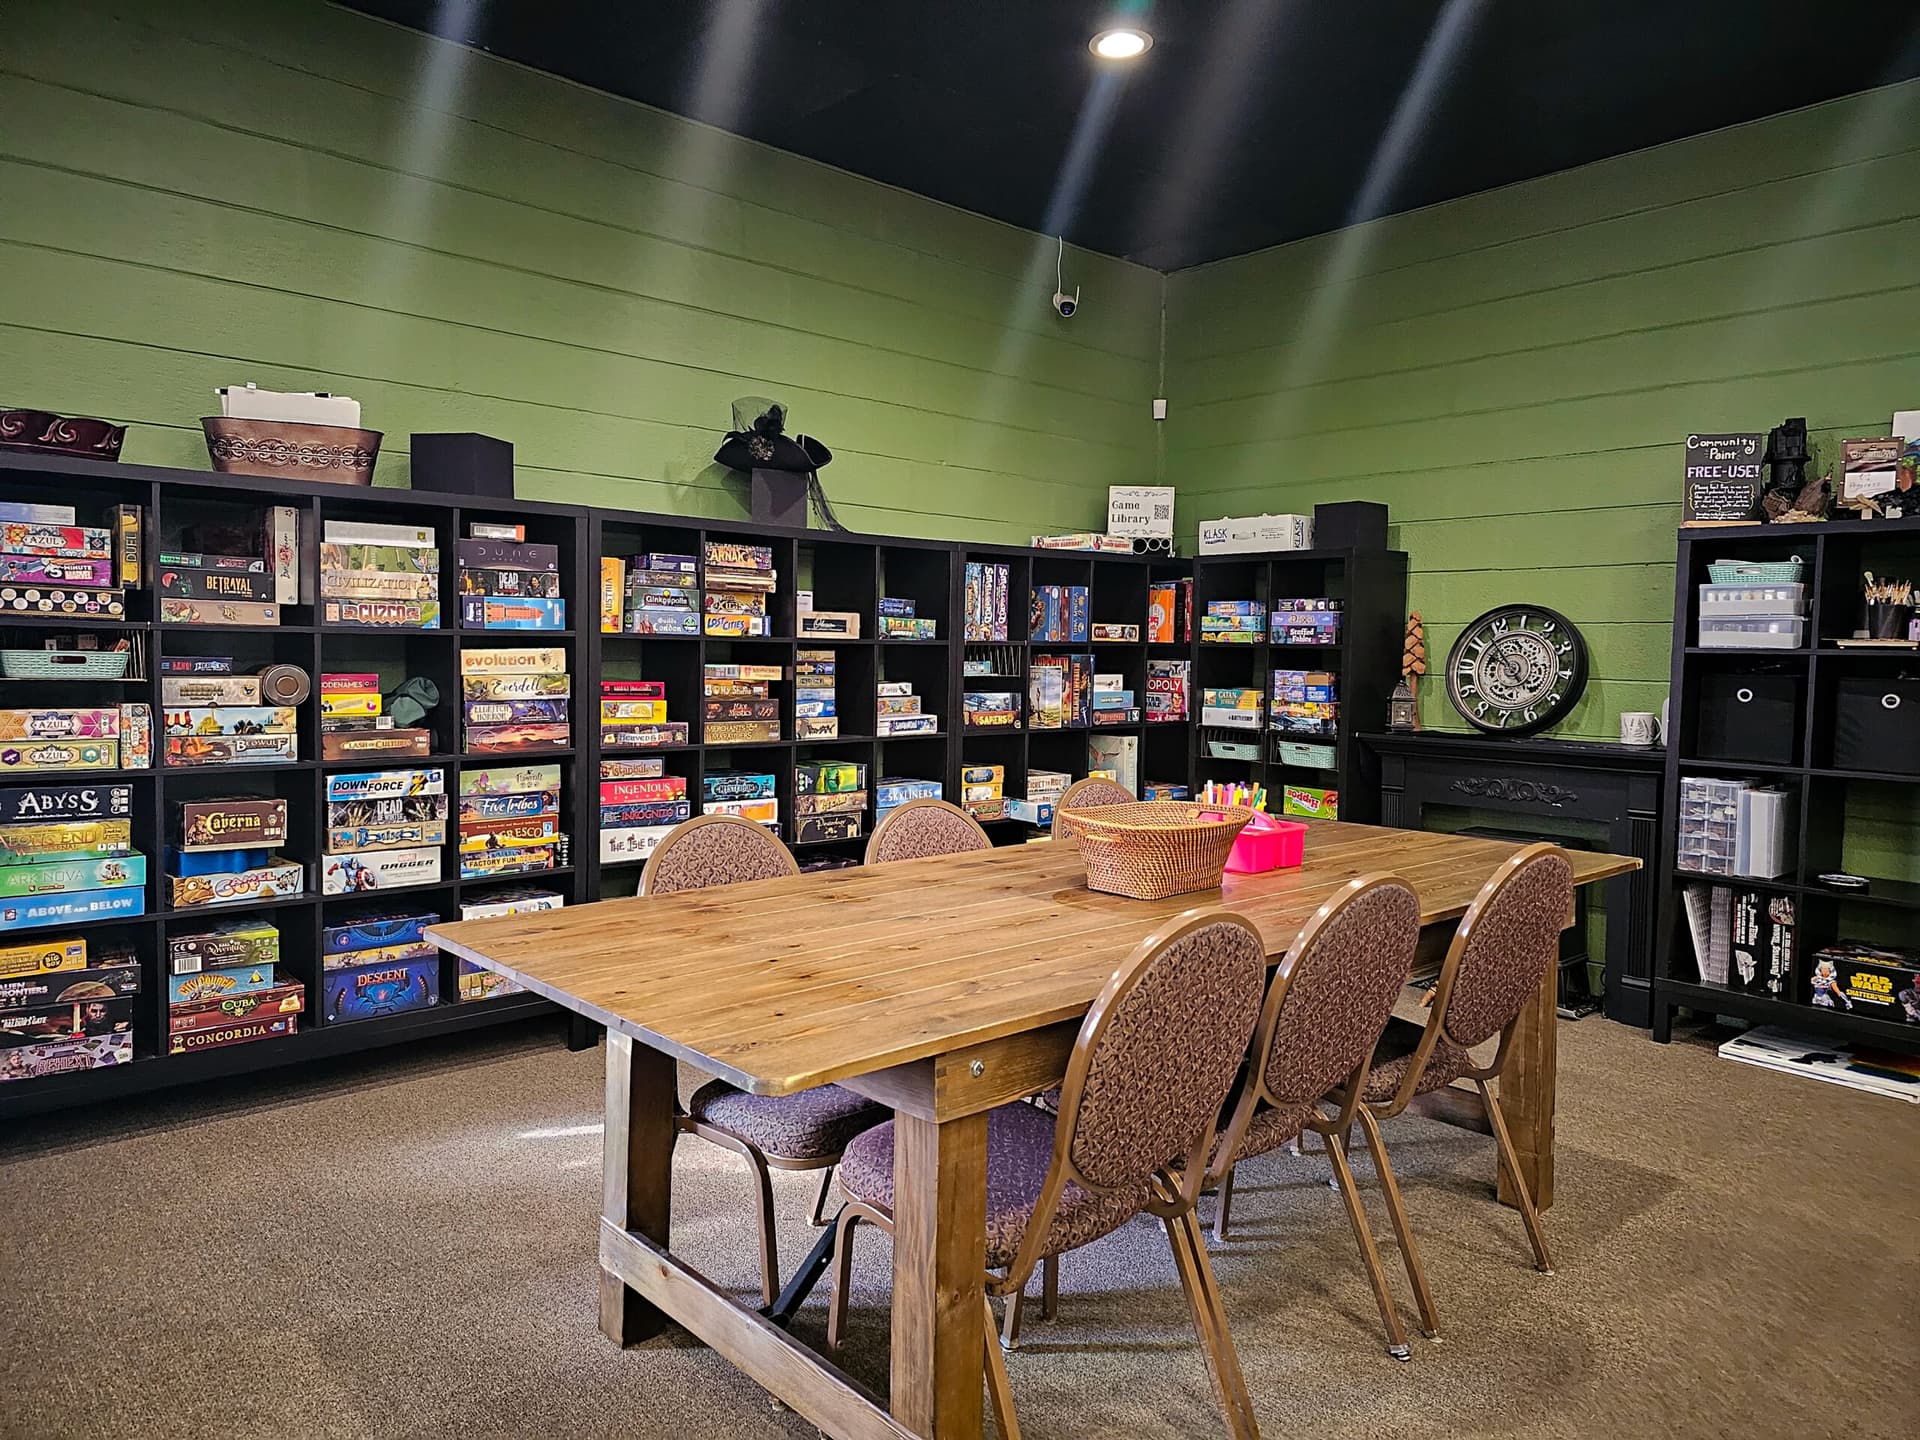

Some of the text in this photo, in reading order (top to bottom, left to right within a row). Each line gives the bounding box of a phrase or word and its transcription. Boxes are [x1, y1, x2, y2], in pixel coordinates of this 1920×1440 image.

[1687, 435, 1755, 454] Community
[1709, 448, 1737, 460] Paint
[1687, 465, 1760, 478] FREE-USE!
[1112, 501, 1140, 510] Game
[1112, 514, 1150, 526] Library
[1204, 528, 1227, 539] KLASK
[30, 536, 60, 545] AZUL
[126, 533, 137, 562] DUEL
[206, 575, 253, 594] BETRAYAL
[327, 576, 418, 590] CIVILIZATION
[499, 572, 518, 584] DEAD
[359, 605, 406, 621] CUZCO
[708, 617, 727, 628] LOST
[723, 620, 745, 631] CITIES
[1492, 618, 1508, 635] 12
[1520, 616, 1526, 629] 1
[1290, 628, 1314, 636] Stuffed
[1540, 621, 1555, 638] 2
[1470, 637, 1485, 650] 11
[1555, 640, 1571, 655] 3
[466, 654, 536, 667] evolution
[1458, 659, 1474, 675] 10
[1558, 669, 1572, 680] 4
[492, 677, 541, 695] Everdell
[1149, 680, 1180, 691] OPOLY
[1461, 685, 1475, 698] 9
[1547, 689, 1560, 706] 5
[1474, 701, 1489, 717] 8
[1524, 707, 1537, 722] 6
[38, 720, 66, 729] AZUL
[980, 715, 1008, 725] SAPIENS
[1498, 710, 1511, 727] 7
[37, 751, 66, 760] AZUL
[614, 783, 671, 795] INGENIOUS
[887, 788, 933, 802] SKYLINERS
[18, 790, 97, 814] ABYSS
[378, 800, 403, 814] DEAD
[481, 796, 538, 816] Five Tribes
[206, 813, 261, 834] Caverna
[380, 860, 434, 870] DAGGER
[469, 858, 500, 868] FACTORY
[43, 870, 85, 881] NOVA
[27, 904, 73, 918] ABOVE
[90, 898, 133, 911] BELOW
[358, 968, 408, 986] DESCENT
[222, 998, 256, 1010] CUBA
[187, 1025, 266, 1046] CONCORDIA
